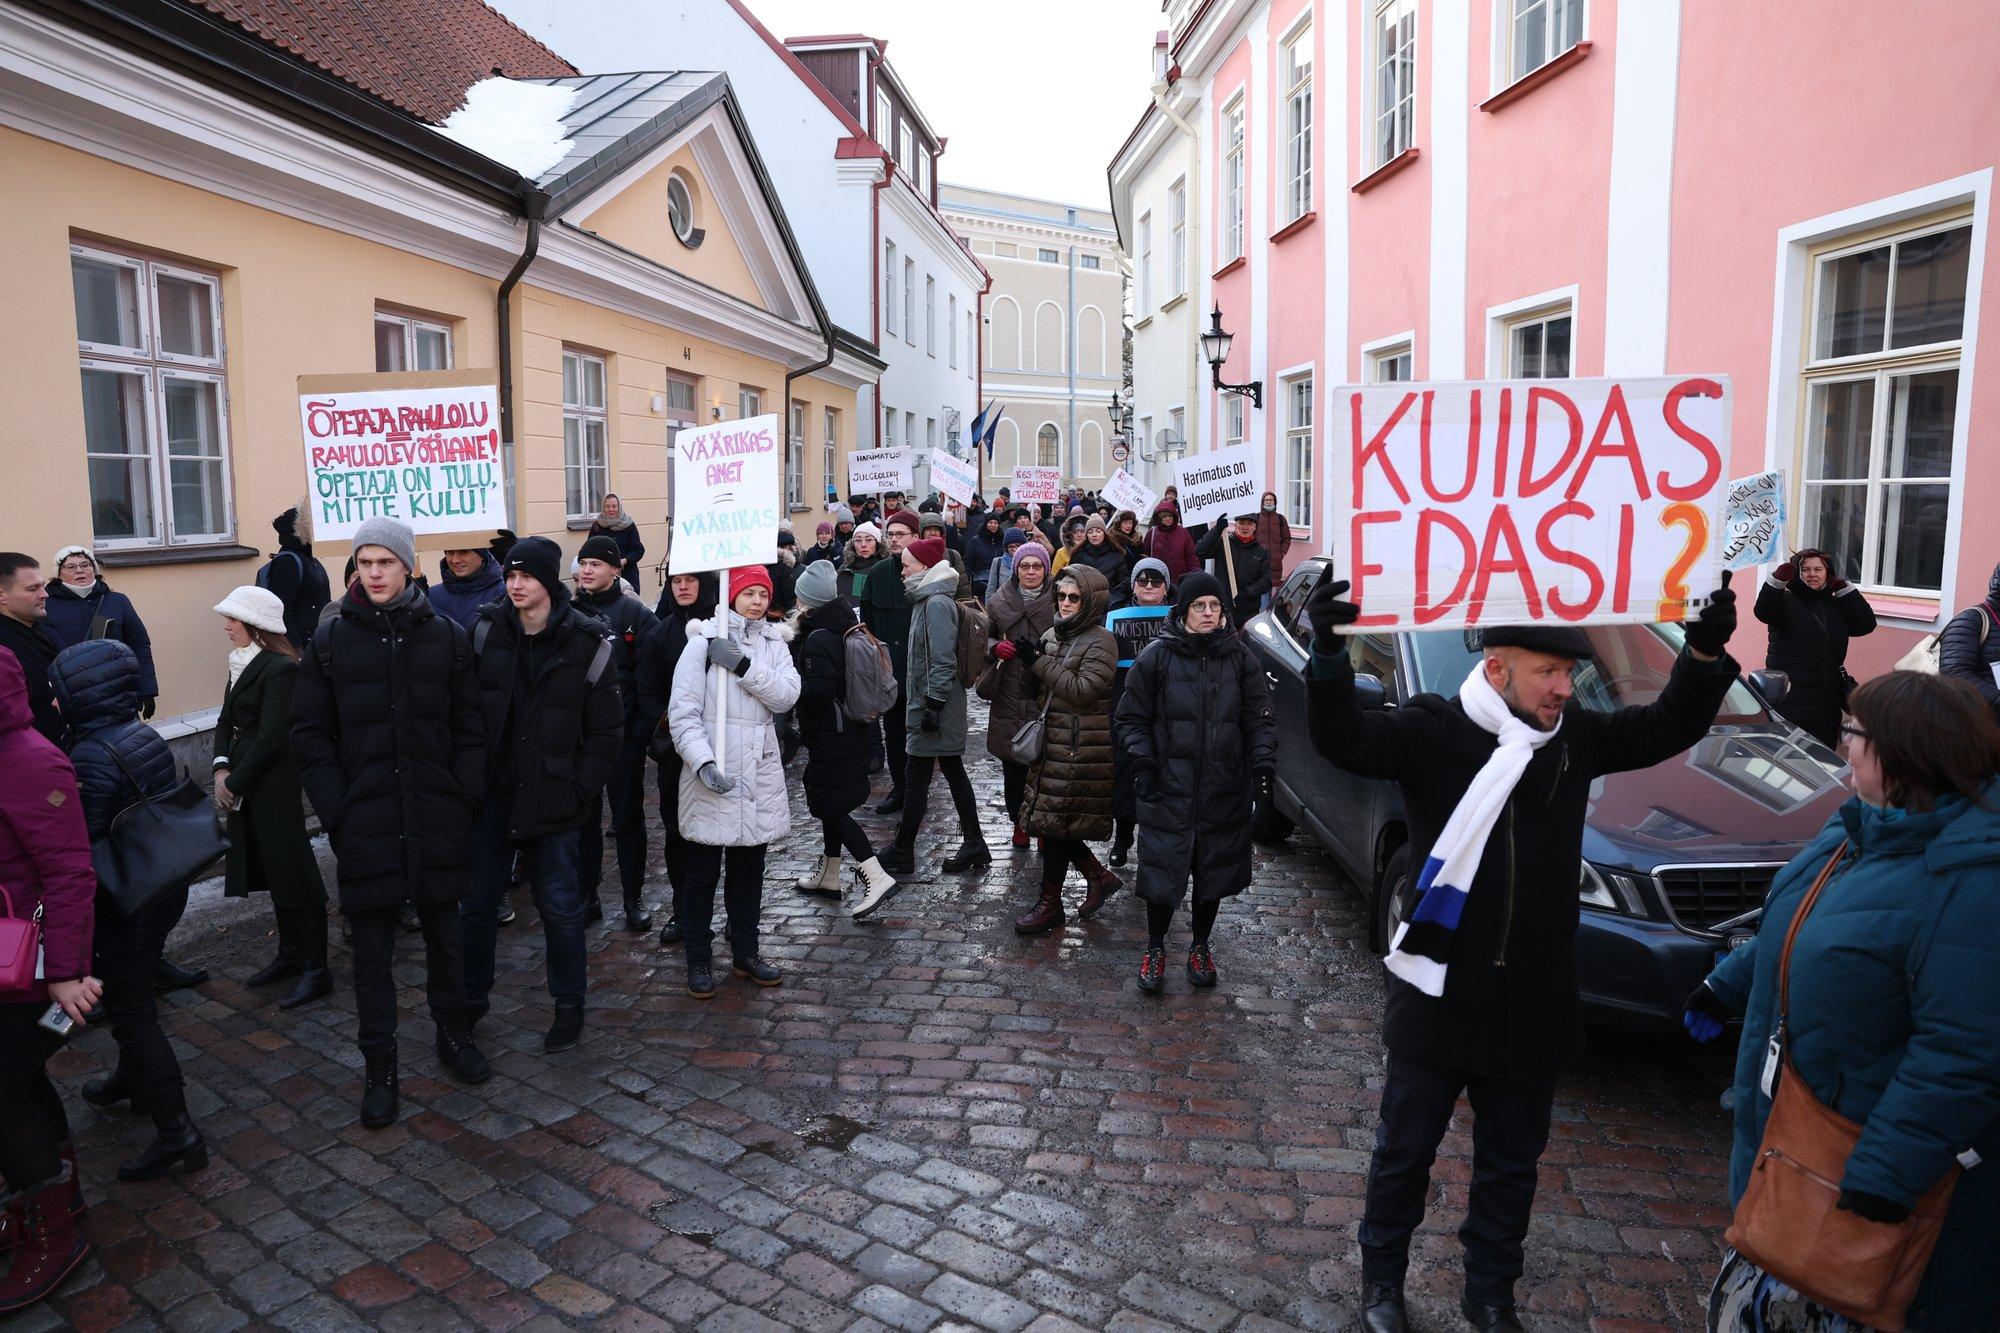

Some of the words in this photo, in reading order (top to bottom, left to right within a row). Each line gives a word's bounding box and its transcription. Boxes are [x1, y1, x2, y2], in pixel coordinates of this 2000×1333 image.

[307, 399, 398, 437] ÕPETAJA
[398, 401, 488, 432] RAHULOLU
[681, 428, 774, 462] VÄÄRIKAS
[856, 452, 901, 462] HARIMATUS
[1351, 378, 1723, 509] KUIDAS
[315, 465, 398, 498] ÕPETAJA
[403, 466, 431, 492] ON
[441, 463, 498, 490] TULU,
[1016, 470, 1031, 479] KES
[1183, 464, 1232, 487] Harimatus
[1233, 461, 1246, 475] on
[1758, 474, 1776, 489] ON
[322, 495, 399, 523] MITTE
[409, 488, 486, 518] KULU!
[1183, 480, 1254, 513] julgeolekurisk!
[682, 508, 776, 537] VÄÄRIKAS
[701, 535, 754, 562] PALK
